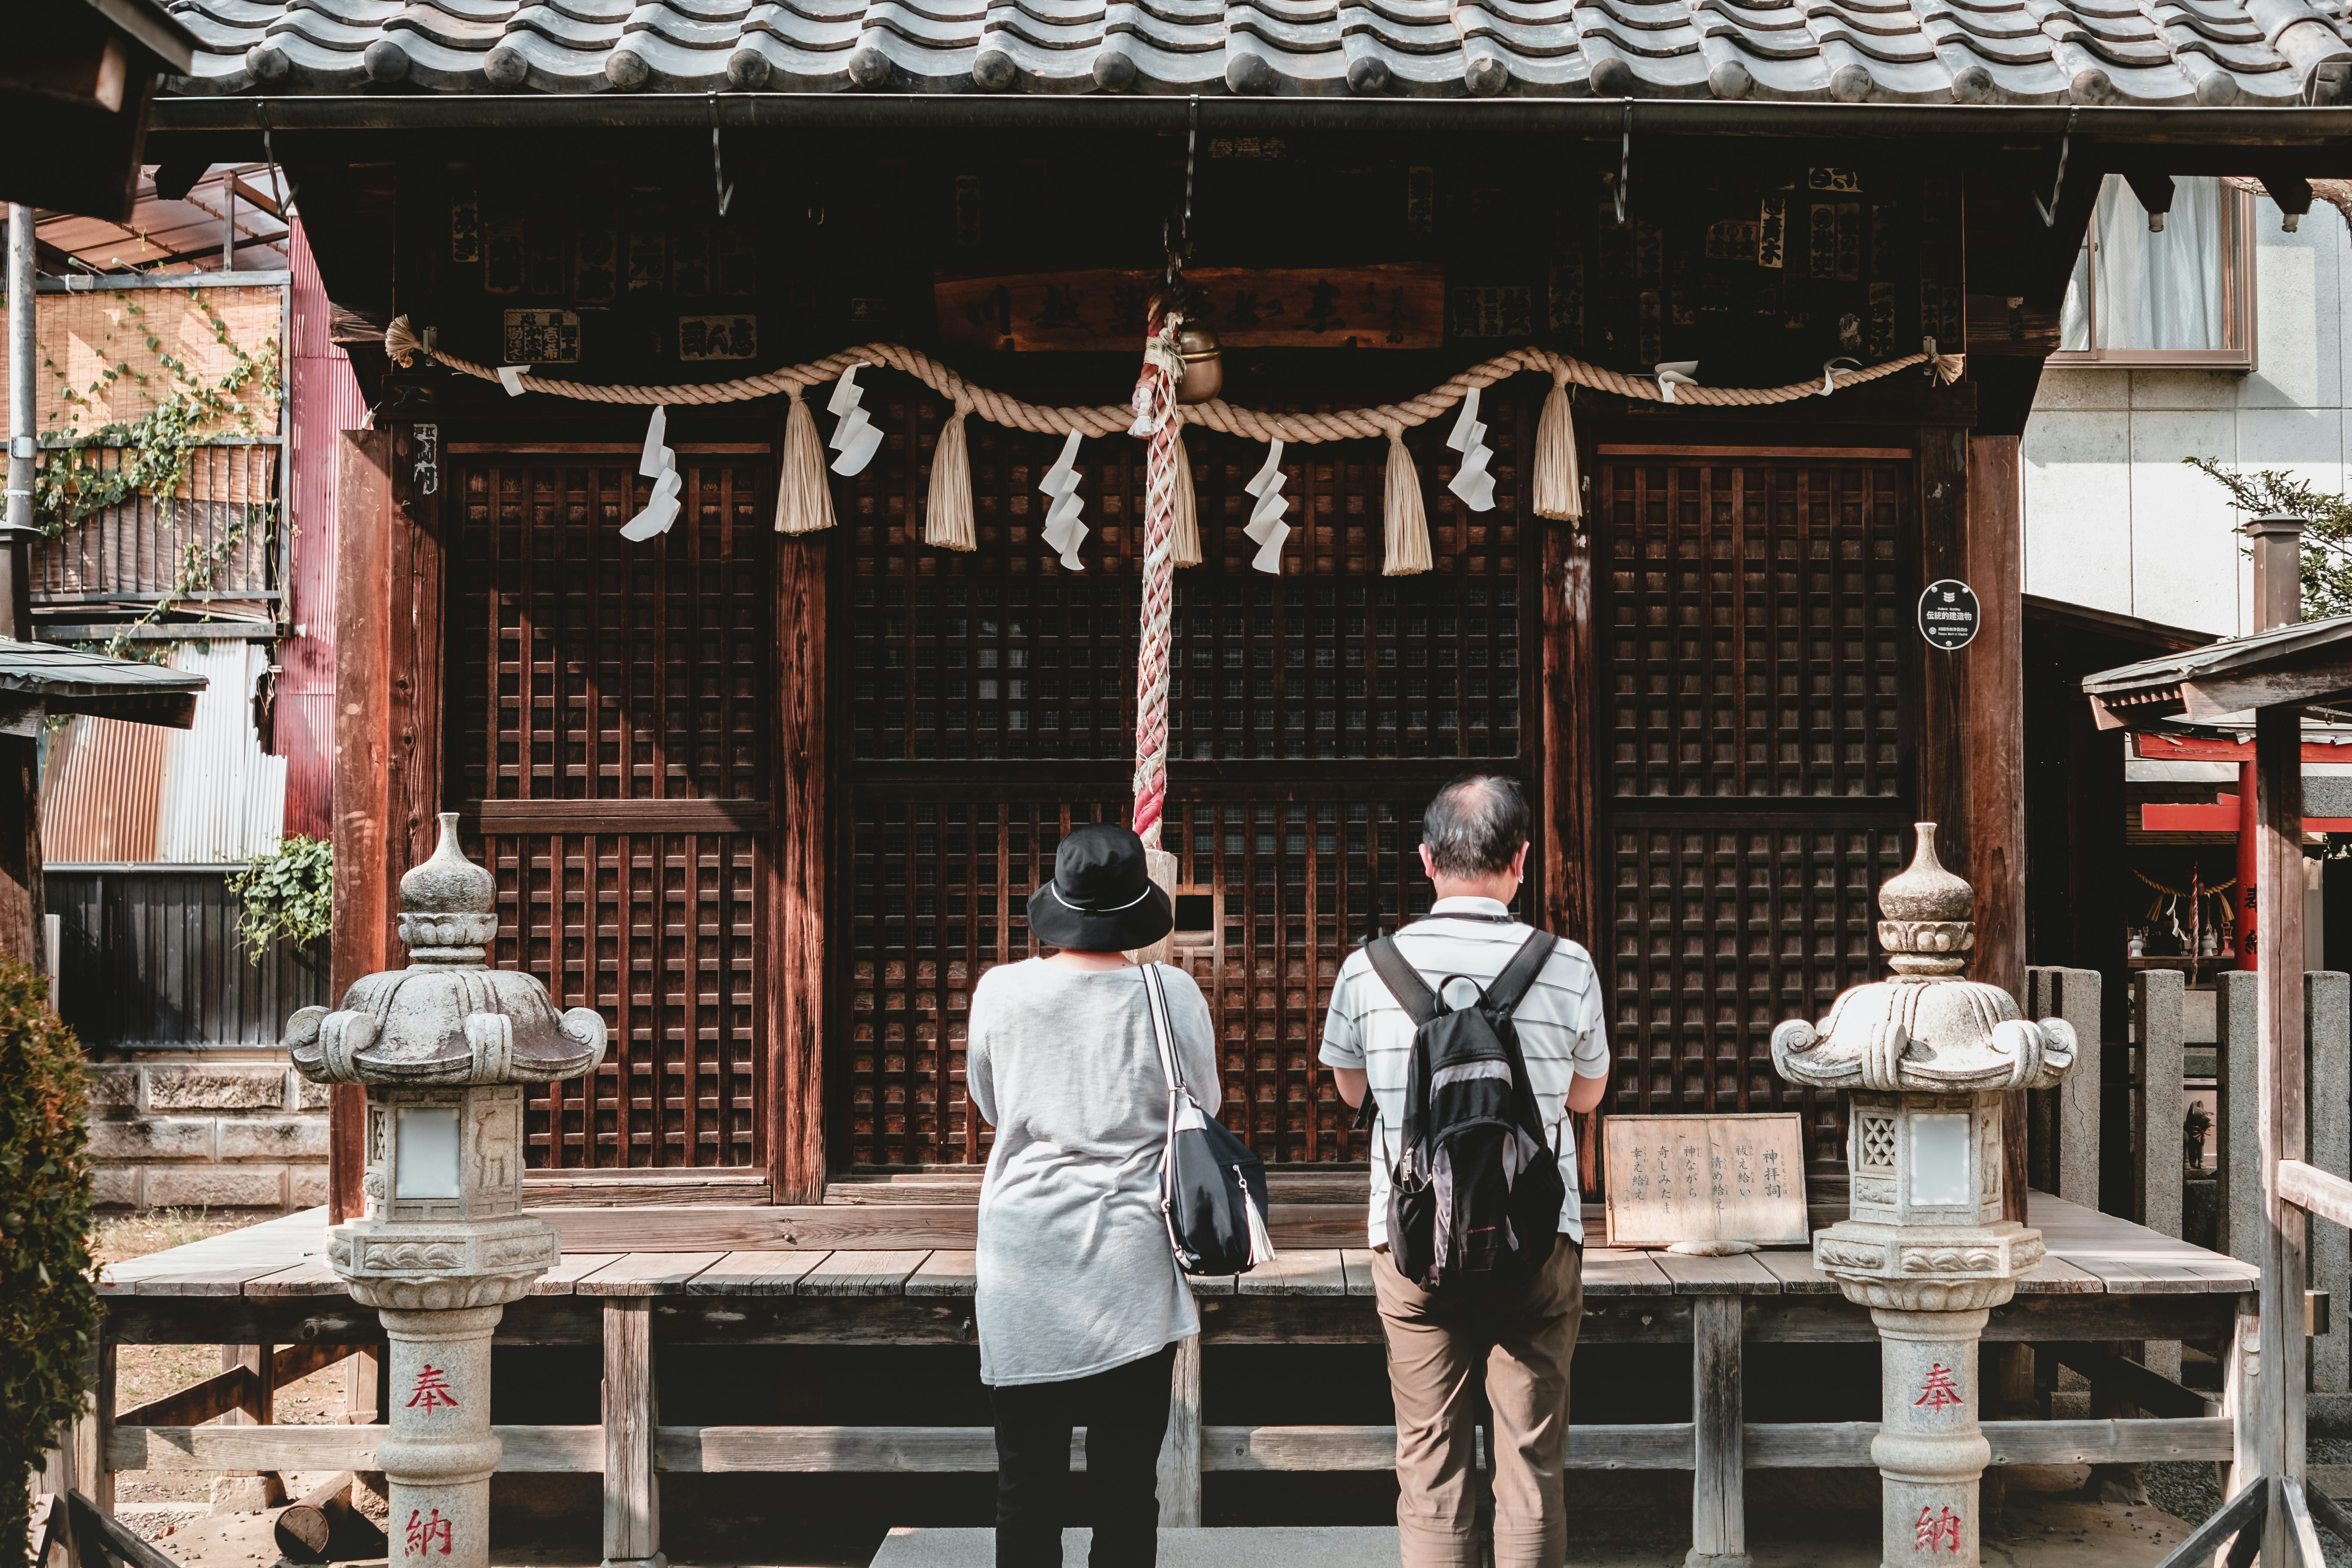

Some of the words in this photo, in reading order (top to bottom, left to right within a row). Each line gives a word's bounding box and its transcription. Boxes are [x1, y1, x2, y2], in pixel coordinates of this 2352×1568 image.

[1926, 611, 1972, 620] 伝統的建造物
[1631, 1146, 1644, 1200] 幸え給え
[1657, 1145, 1671, 1214] 奇しみたま
[1683, 1145, 1698, 1198] 神ながら
[1711, 1156, 1725, 1210] 清め給え
[1735, 1145, 1751, 1196] 祓え給い
[1762, 1149, 1781, 1198] 神拝詞
[404, 1363, 459, 1558] 奉納
[1914, 1363, 1964, 1555] 奉納
